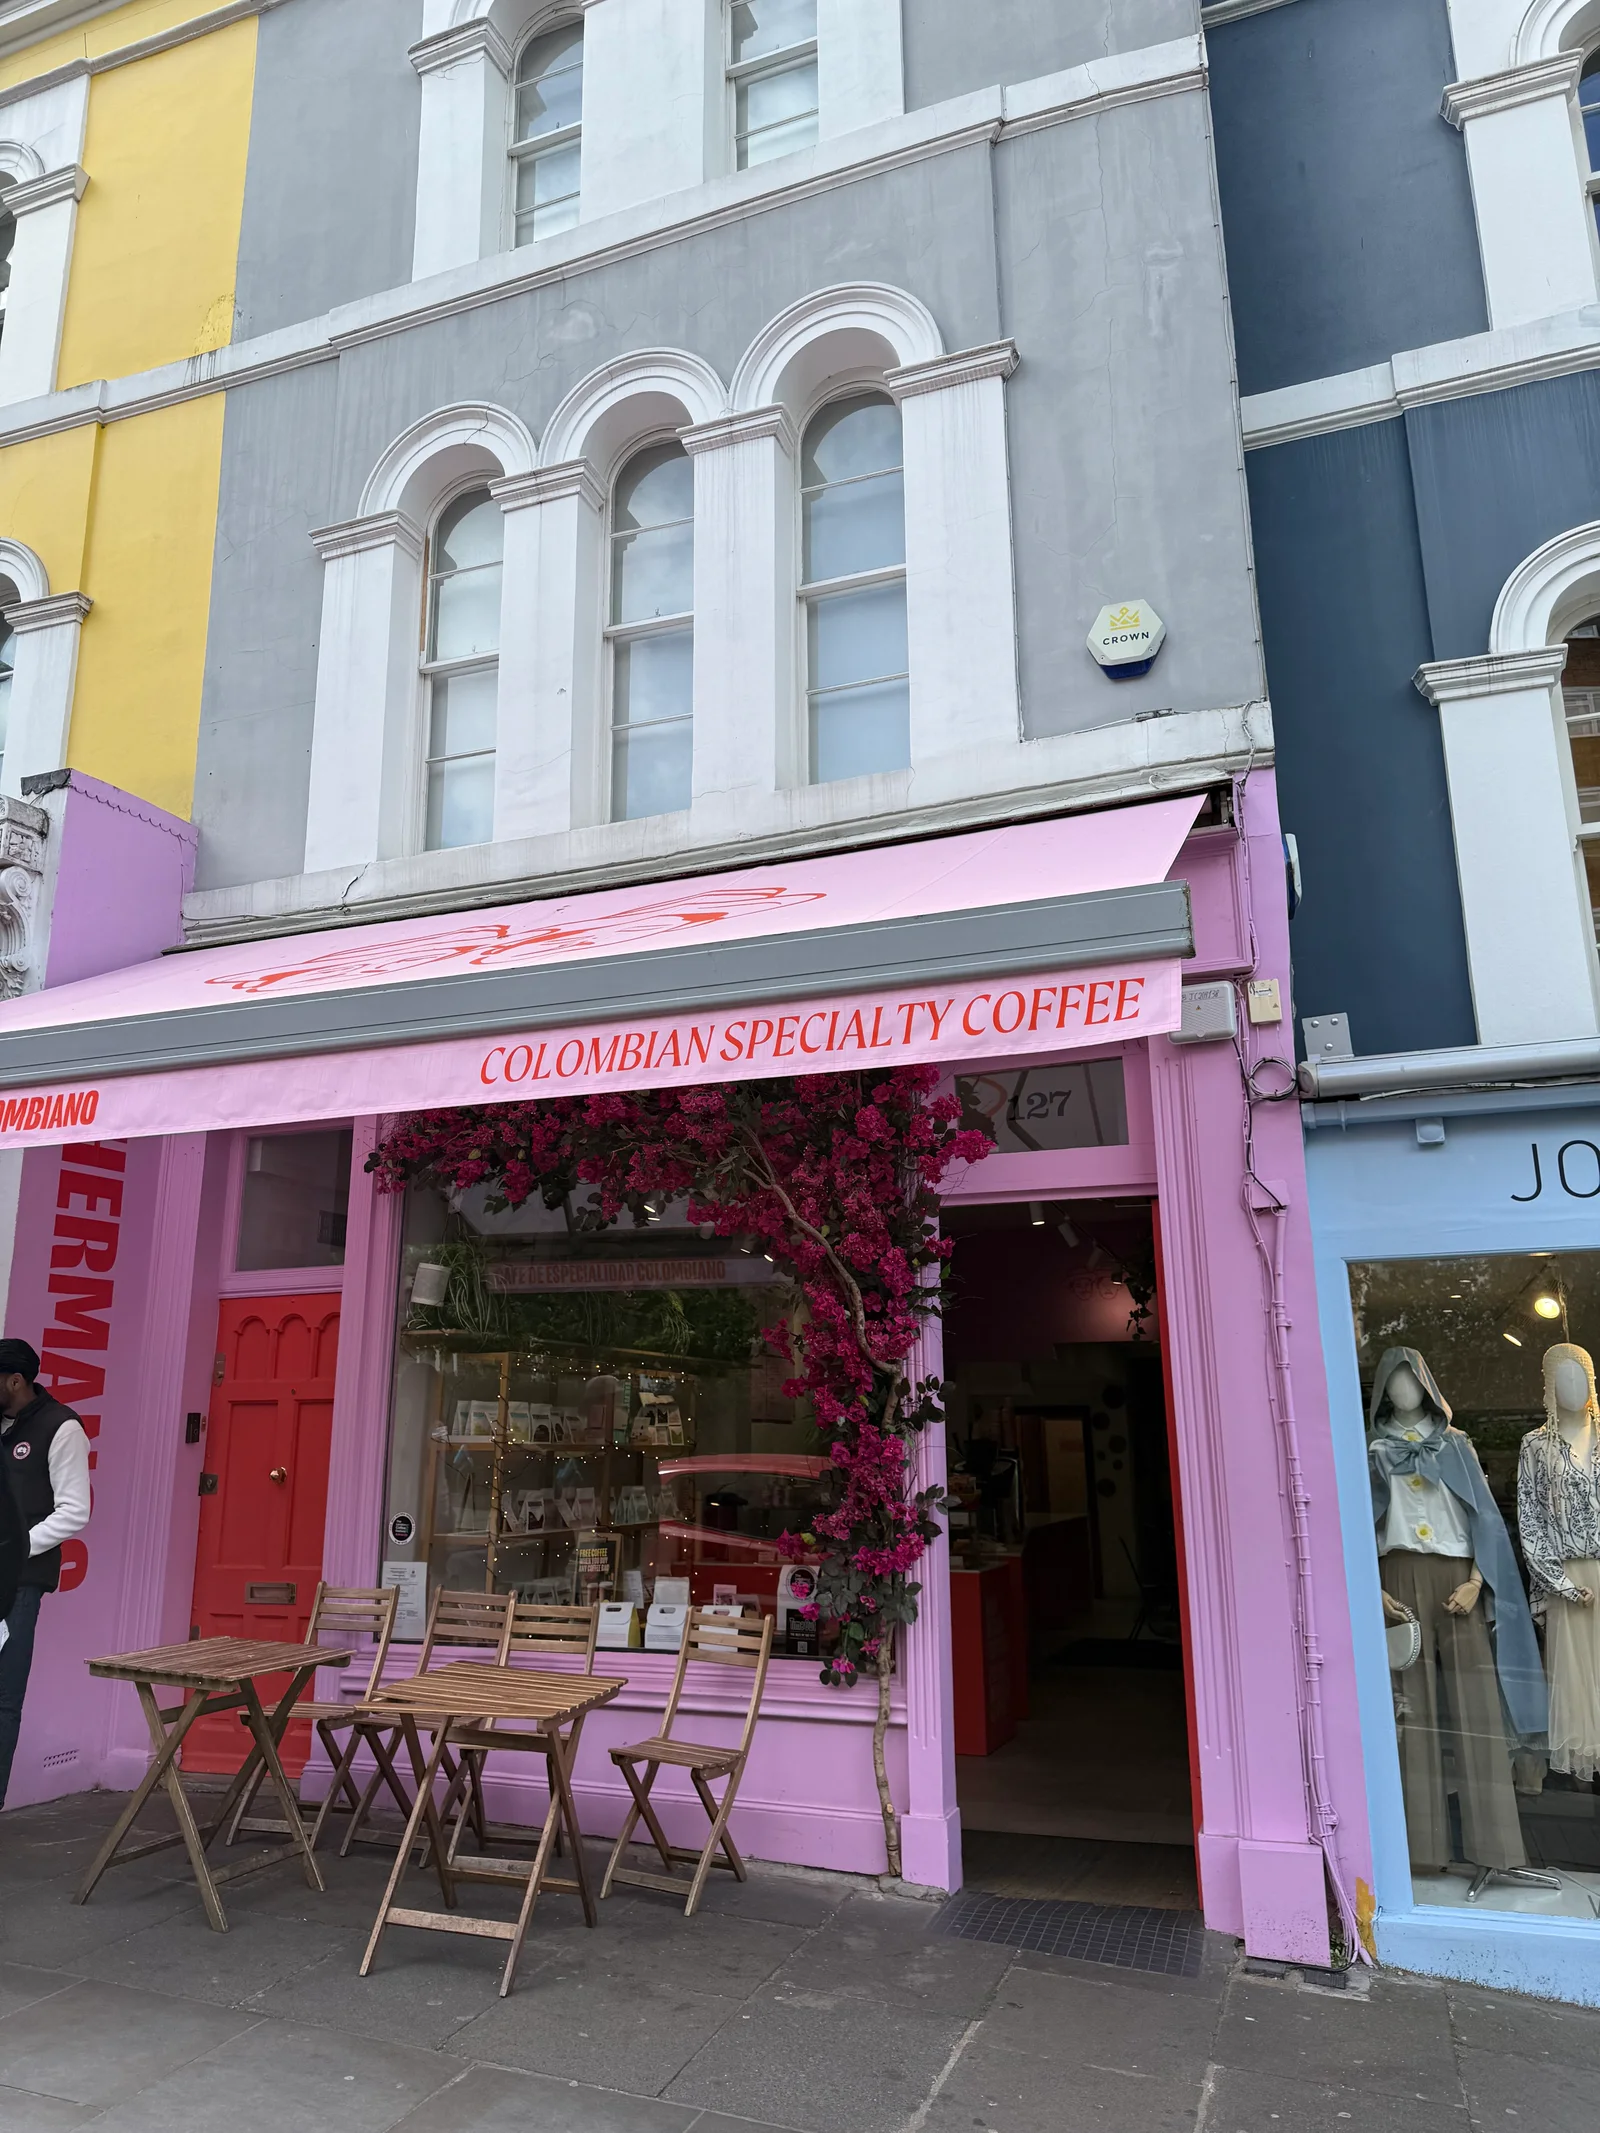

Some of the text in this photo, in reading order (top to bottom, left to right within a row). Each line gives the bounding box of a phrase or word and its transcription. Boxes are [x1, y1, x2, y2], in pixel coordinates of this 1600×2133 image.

[1102, 631, 1150, 645] CROWN
[480, 977, 1145, 1084] COLOMBIAN SPECIALTY COFFEE
[1008, 1090, 1072, 1121] 127
[1510, 1140, 1600, 1202] JO
[40, 1138, 127, 1592] HERMA
